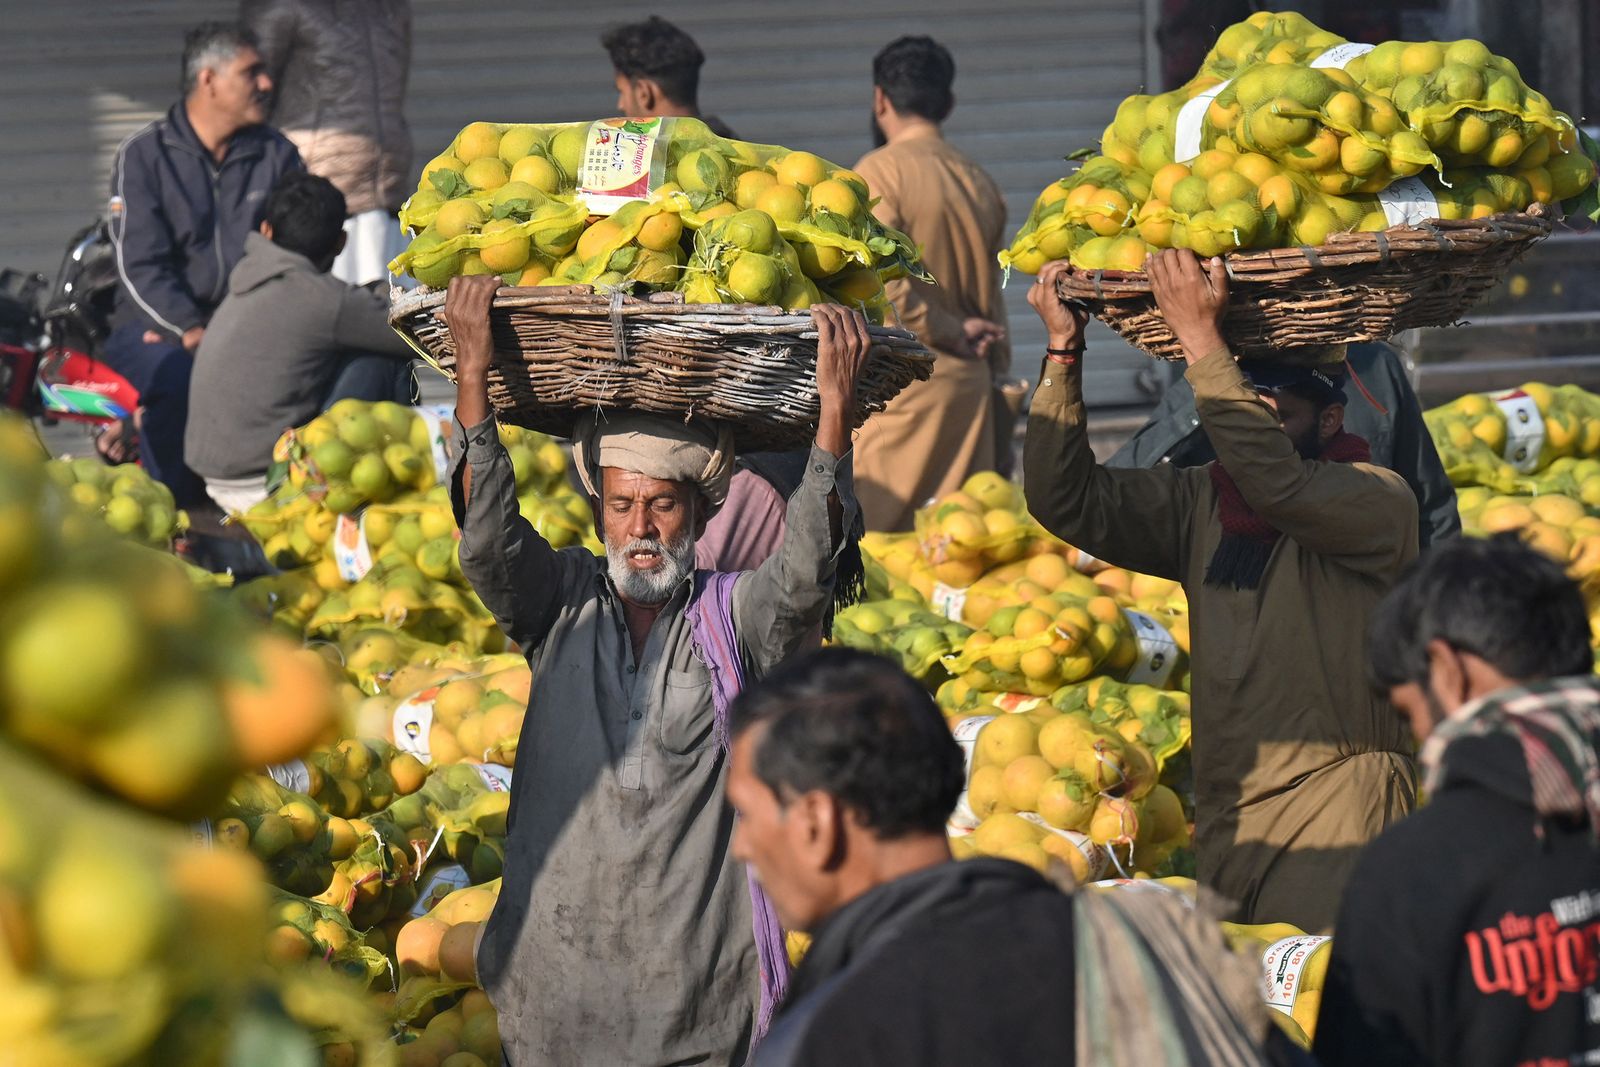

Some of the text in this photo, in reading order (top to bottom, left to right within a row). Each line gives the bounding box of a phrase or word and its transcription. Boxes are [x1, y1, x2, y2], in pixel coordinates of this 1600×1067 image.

[632, 143, 647, 176] Oranges
[1312, 368, 1334, 388] puma
[1264, 968, 1276, 1000] Fresh
[1282, 973, 1295, 999] 100
[1292, 950, 1305, 966] 80
